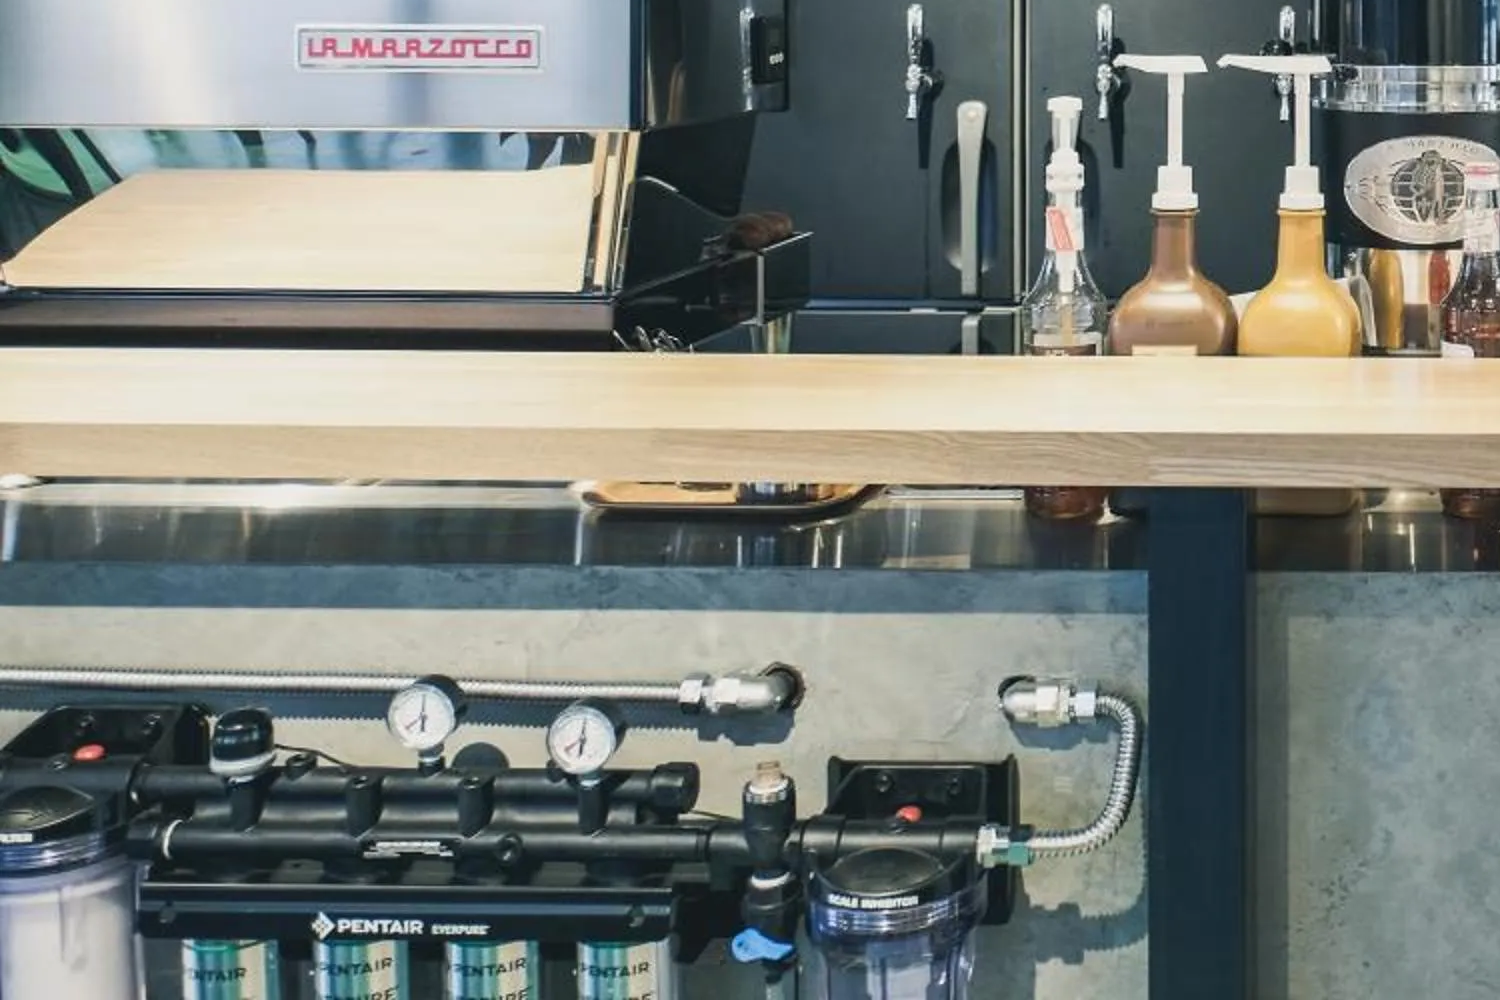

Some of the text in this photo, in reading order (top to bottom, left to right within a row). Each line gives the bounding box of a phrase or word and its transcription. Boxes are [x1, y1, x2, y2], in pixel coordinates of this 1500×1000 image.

[307, 38, 337, 57] LA
[337, 919, 490, 935] PENTAIR EVERPURE
